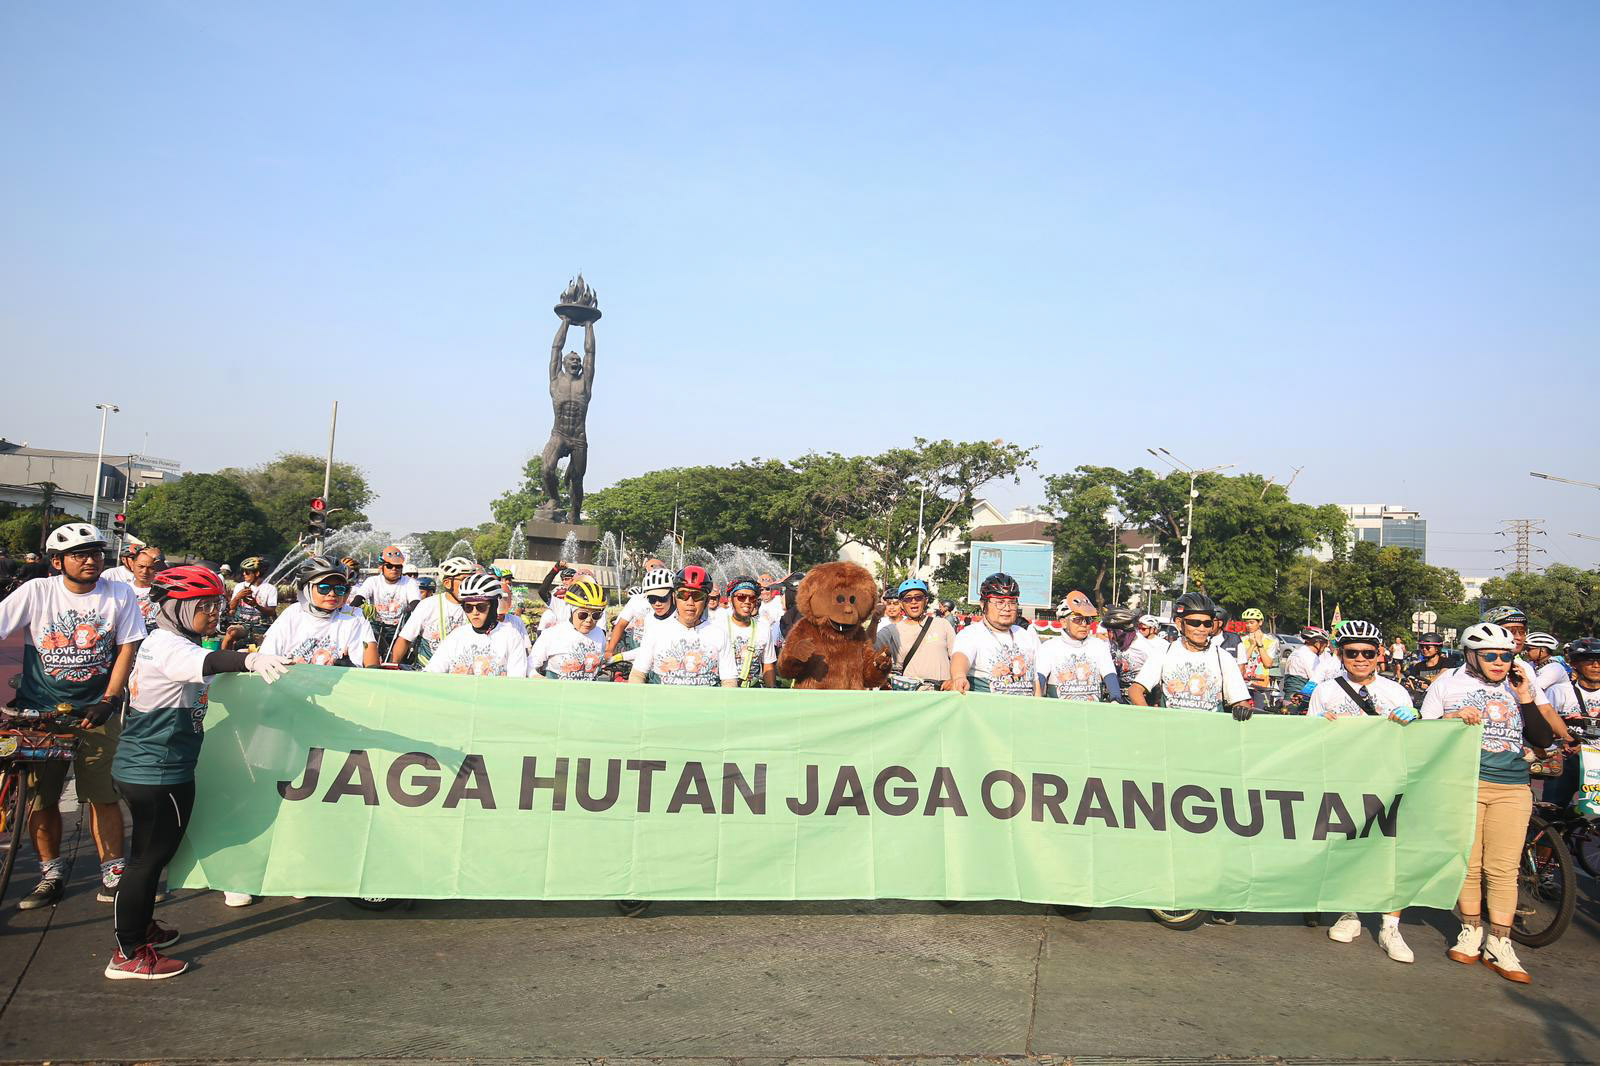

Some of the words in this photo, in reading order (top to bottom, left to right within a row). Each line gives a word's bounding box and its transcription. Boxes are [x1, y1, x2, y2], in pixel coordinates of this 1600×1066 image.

[52, 646, 76, 654] LOVE
[44, 653, 106, 664] ORANGUTAN
[1172, 691, 1190, 699] LOVE
[1169, 698, 1215, 709] ORANGUTAN
[1491, 721, 1506, 729] FOR
[1483, 727, 1520, 738] NGUTAN
[277, 747, 497, 810] JAGA
[518, 756, 768, 815] HUTAN
[785, 764, 969, 817] JAGA
[981, 769, 1404, 841] ORANGUTAN
